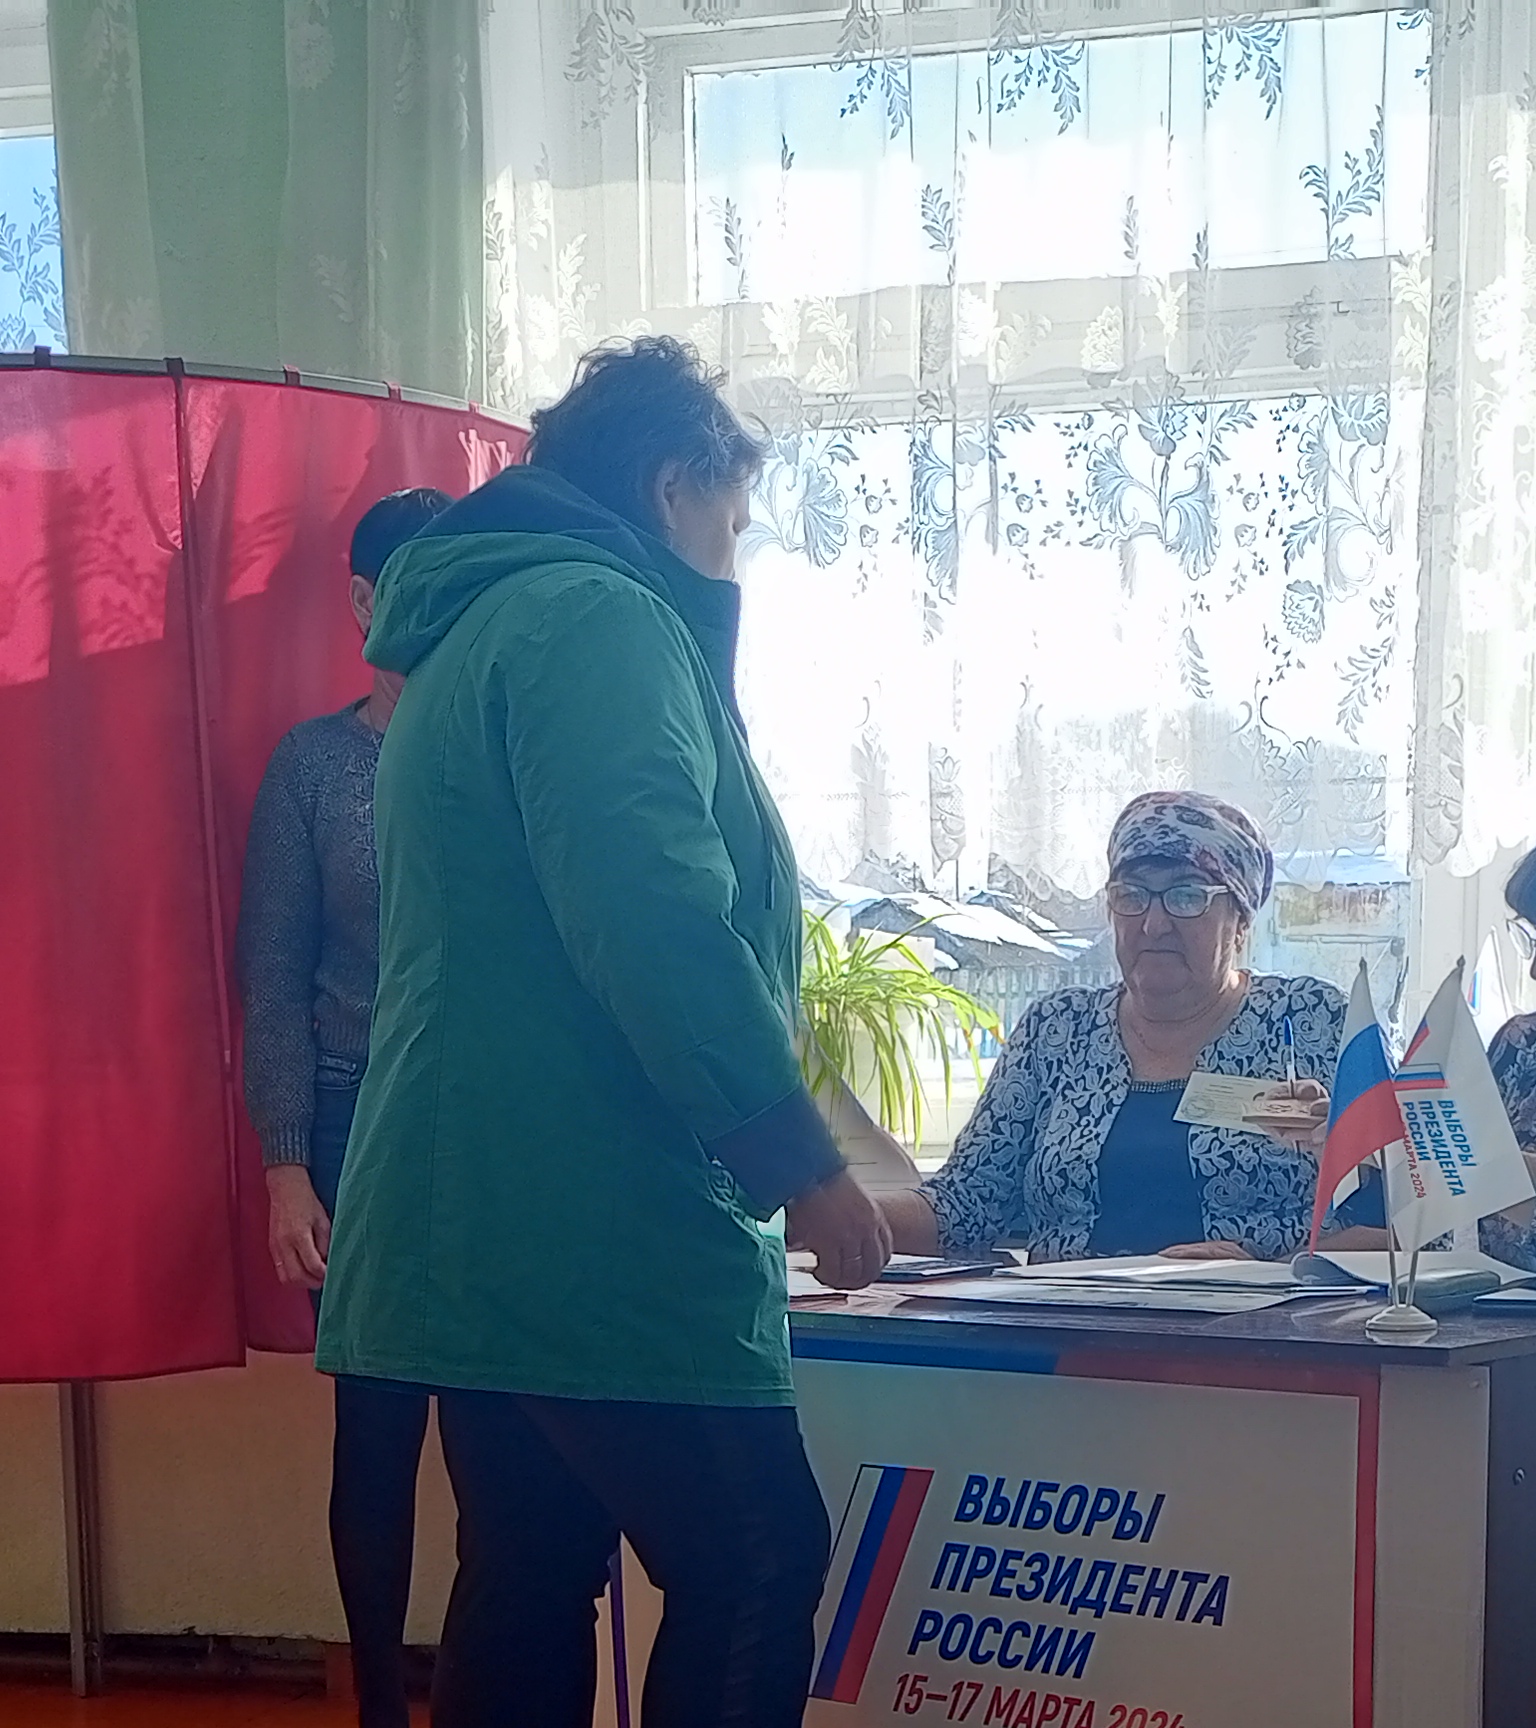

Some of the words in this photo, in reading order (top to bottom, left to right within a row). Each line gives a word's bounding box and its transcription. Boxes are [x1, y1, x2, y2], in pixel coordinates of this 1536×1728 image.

[1403, 1102, 1432, 1161] РОССИИ
[1418, 1100, 1466, 1196] ПРЕЗИДЕНТА
[1437, 1100, 1477, 1166] ВЫБОРЫ
[1410, 1172, 1427, 1198] 2024
[953, 1474, 1166, 1544] ВЫБОРЫ
[930, 1542, 1230, 1626] ПРЕЗИДЕНТА
[907, 1609, 1096, 1680] РОССИИ
